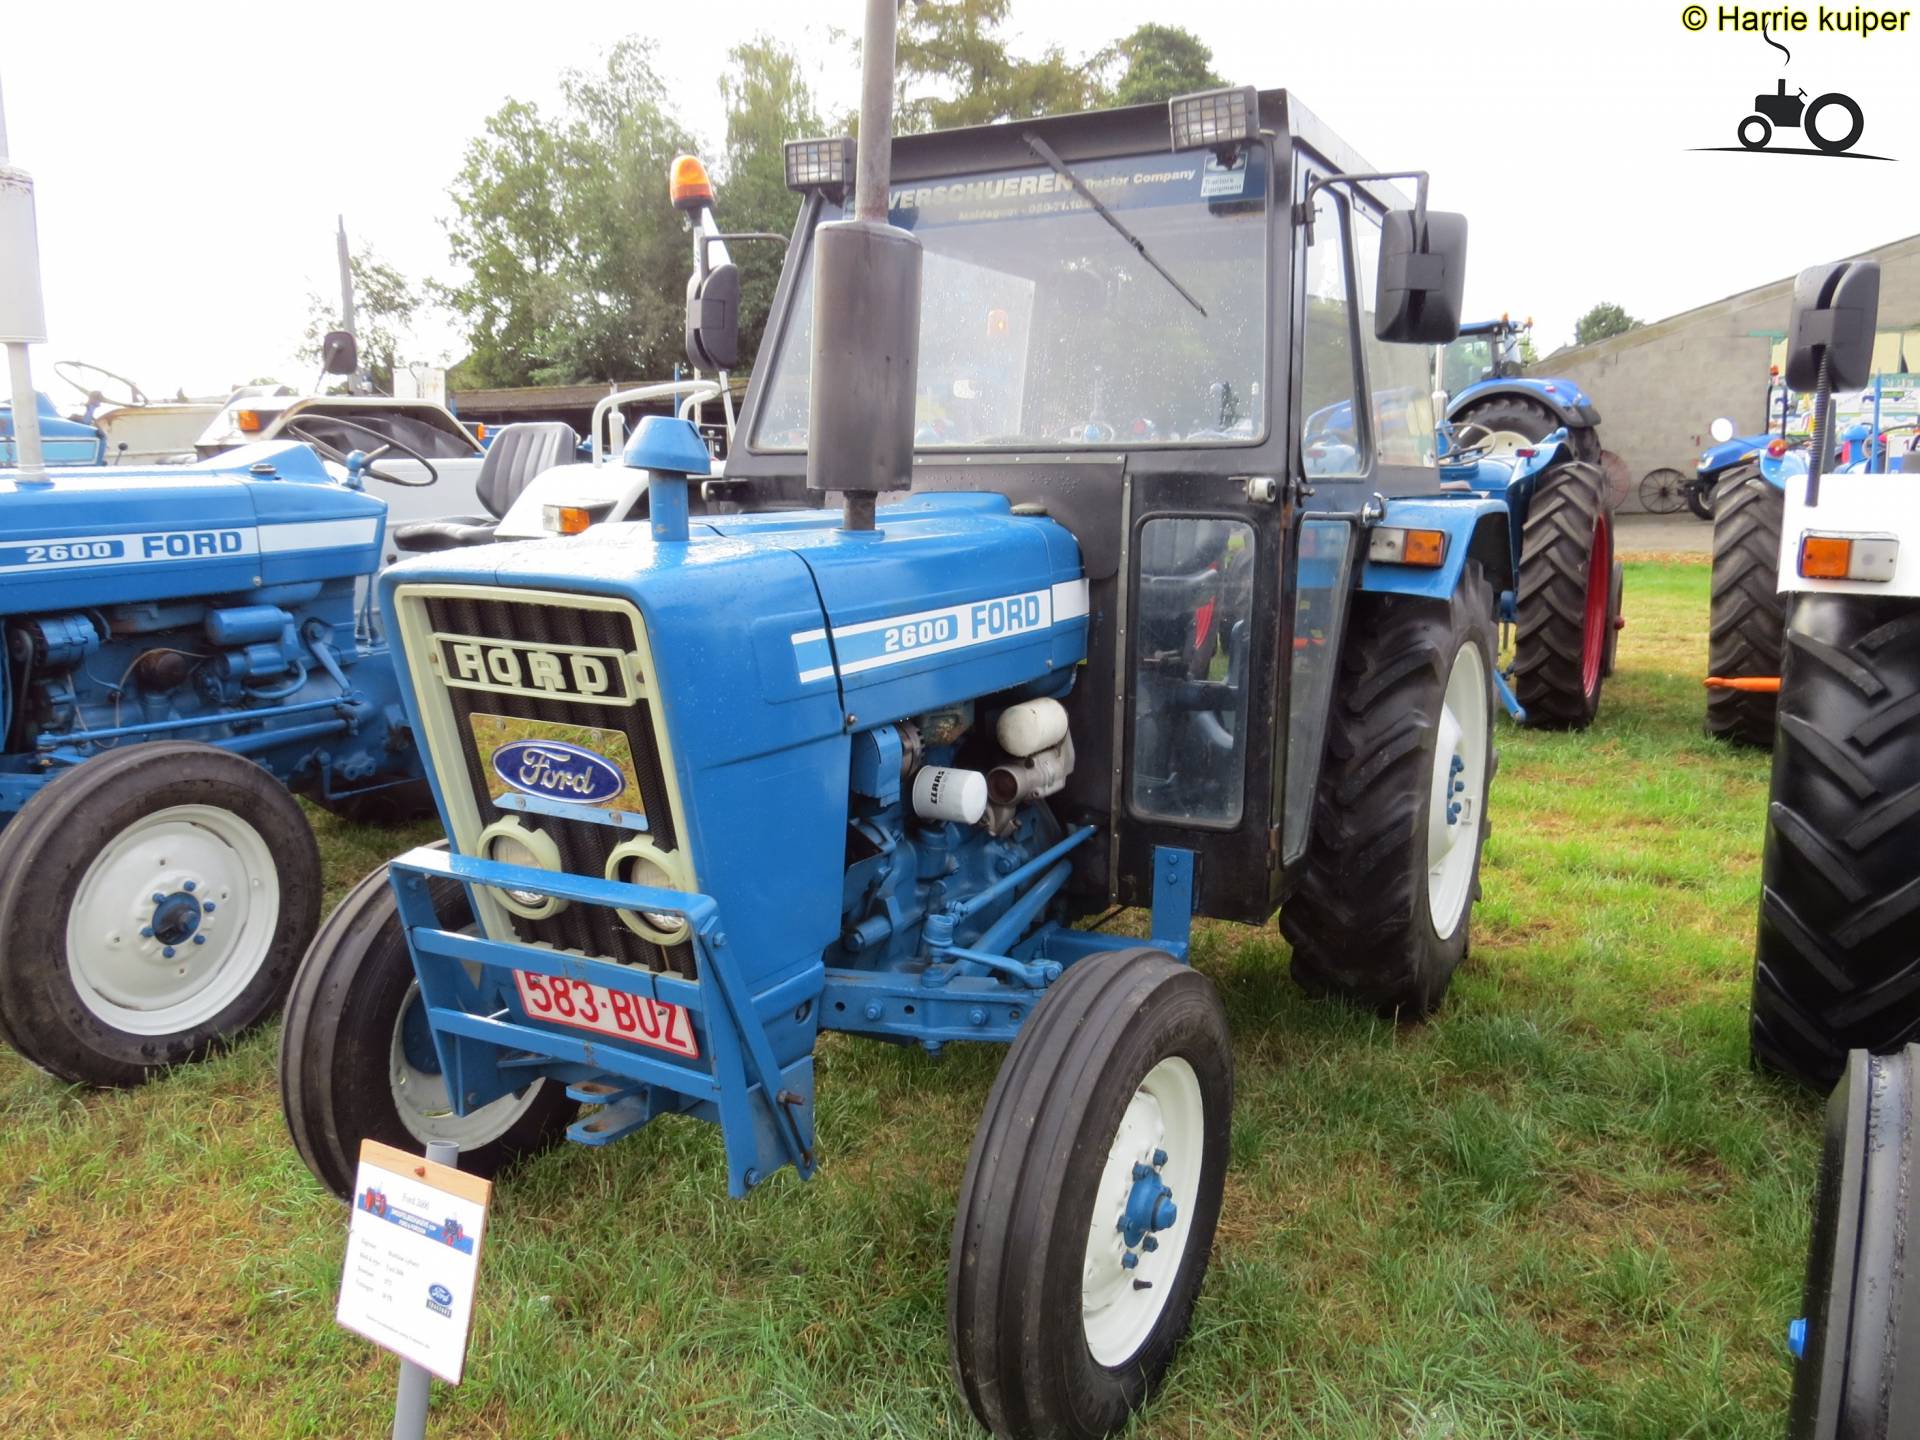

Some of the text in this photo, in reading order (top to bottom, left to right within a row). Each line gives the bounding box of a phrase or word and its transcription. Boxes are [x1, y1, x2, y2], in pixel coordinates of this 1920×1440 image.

[888, 172, 1075, 210] VERSCHUEREN
[1133, 168, 1196, 185] Company
[26, 530, 243, 563] 2600 FORD
[884, 595, 1040, 652] 2600 FORD
[453, 643, 608, 694] FORD
[519, 747, 596, 794] Ford
[930, 769, 946, 805] CLAAS
